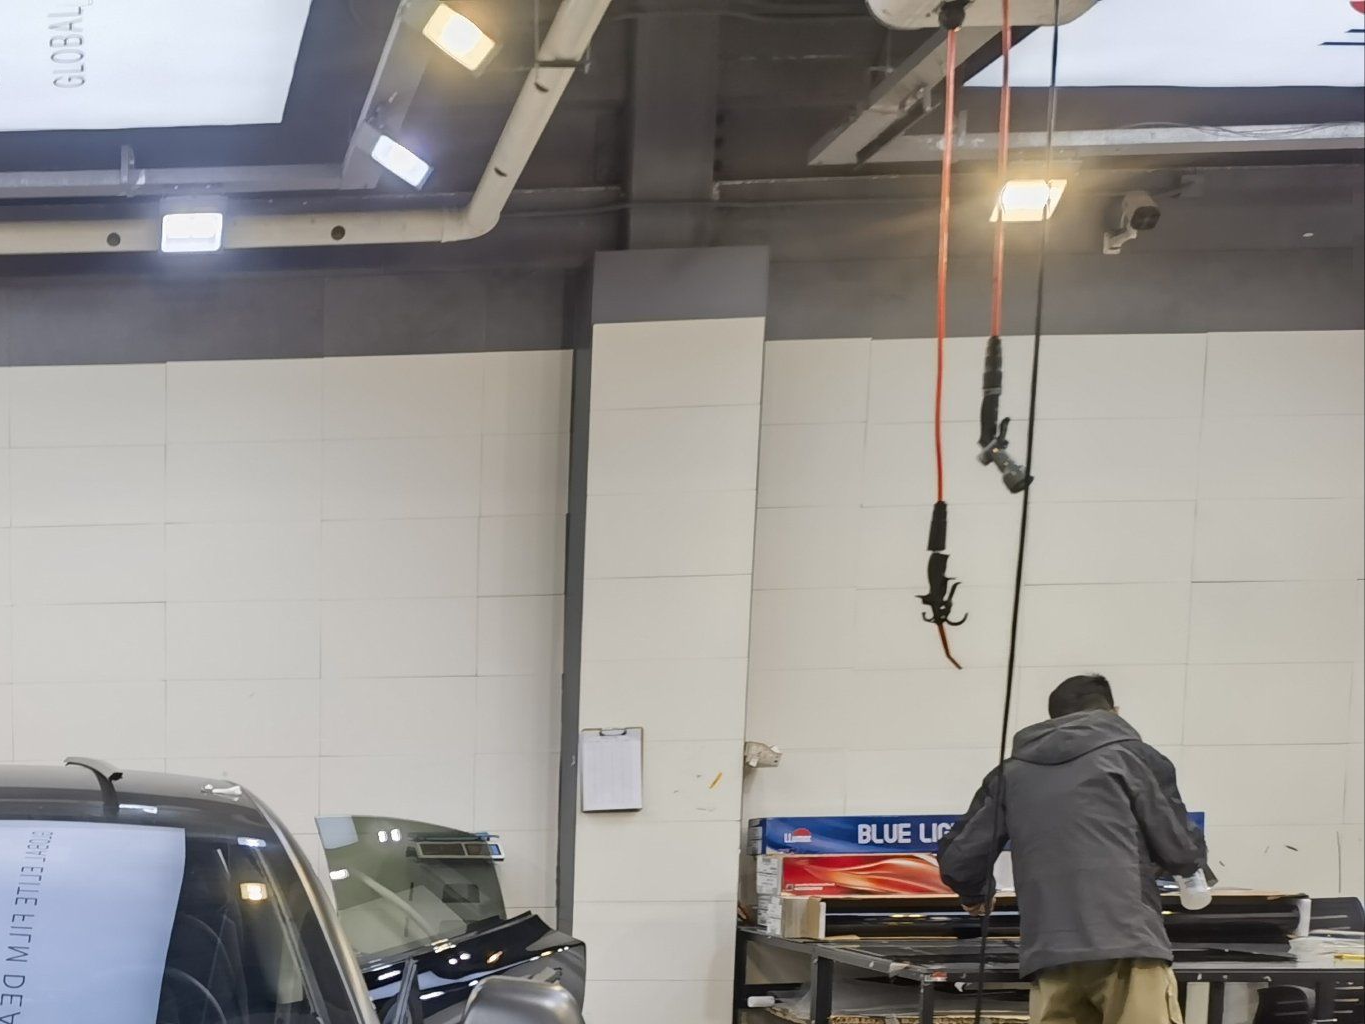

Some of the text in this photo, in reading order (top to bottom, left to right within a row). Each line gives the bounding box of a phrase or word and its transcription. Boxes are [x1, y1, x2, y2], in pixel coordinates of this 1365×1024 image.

[46, 6, 85, 89] GLOBAL
[857, 822, 955, 845] BLUE LIG
